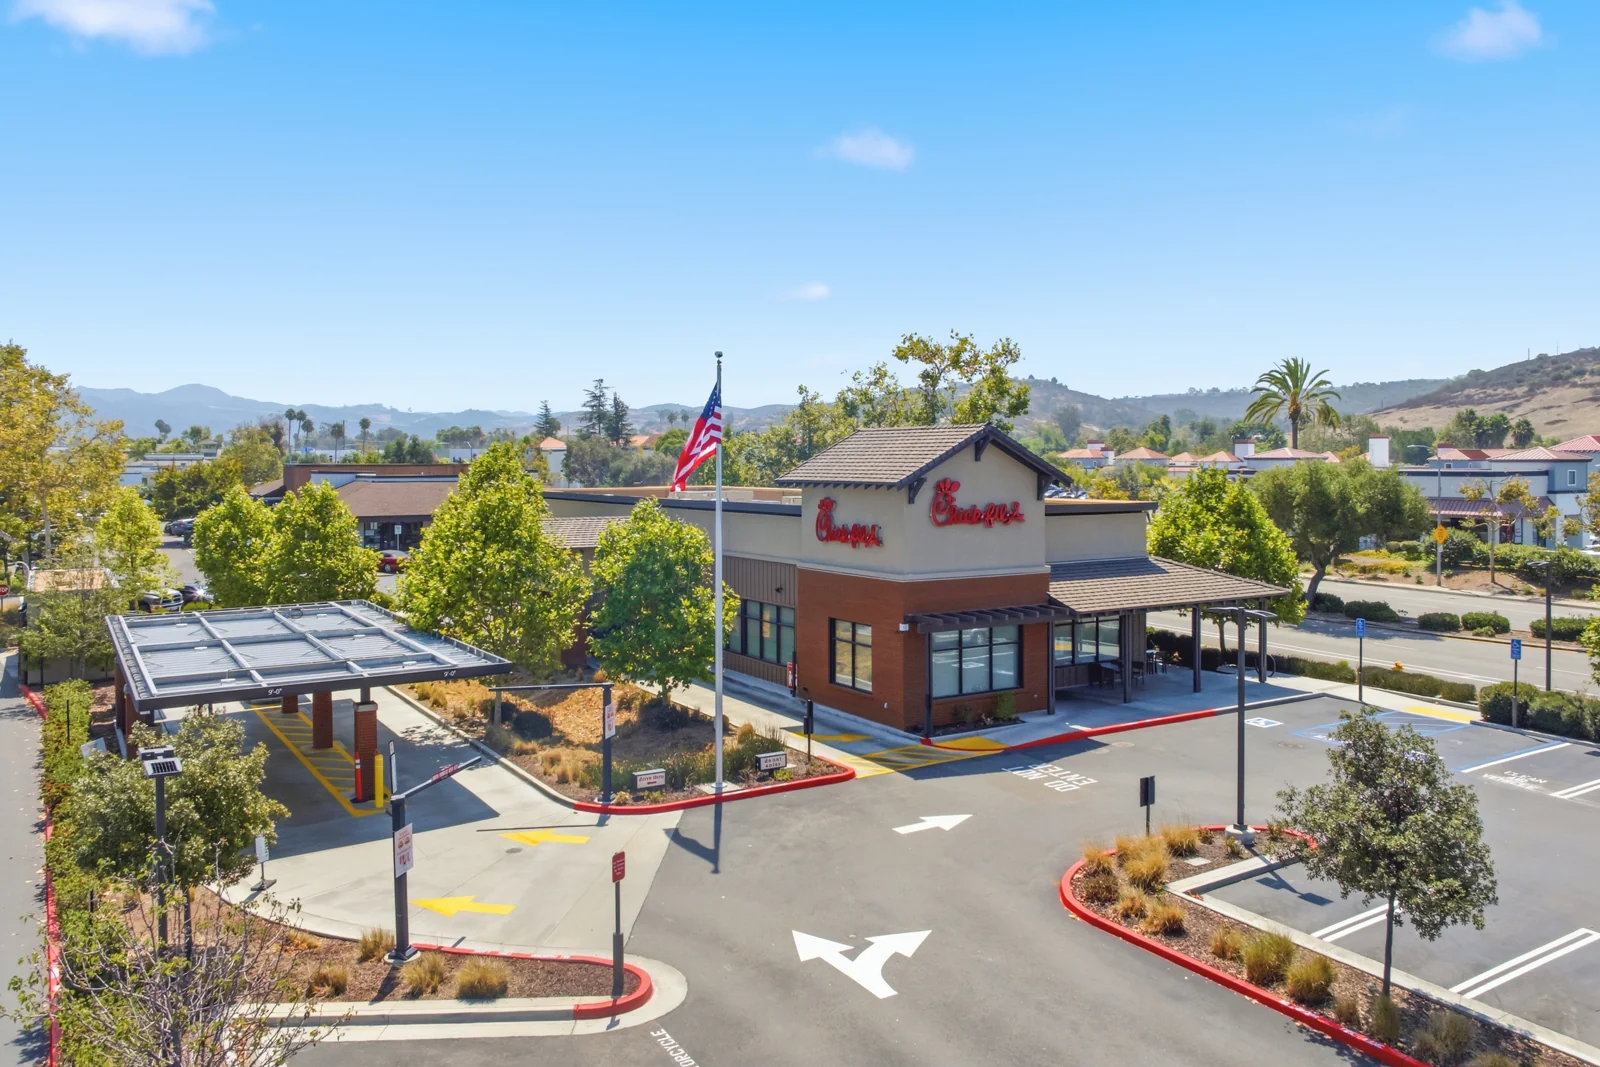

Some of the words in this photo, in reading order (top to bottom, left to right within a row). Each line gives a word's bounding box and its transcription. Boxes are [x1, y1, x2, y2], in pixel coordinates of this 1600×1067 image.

[1001, 765, 1049, 781] NOT
[1028, 762, 1099, 786] ENTER
[1043, 780, 1081, 793] DO
[649, 1028, 700, 1067] ORCYCLE
